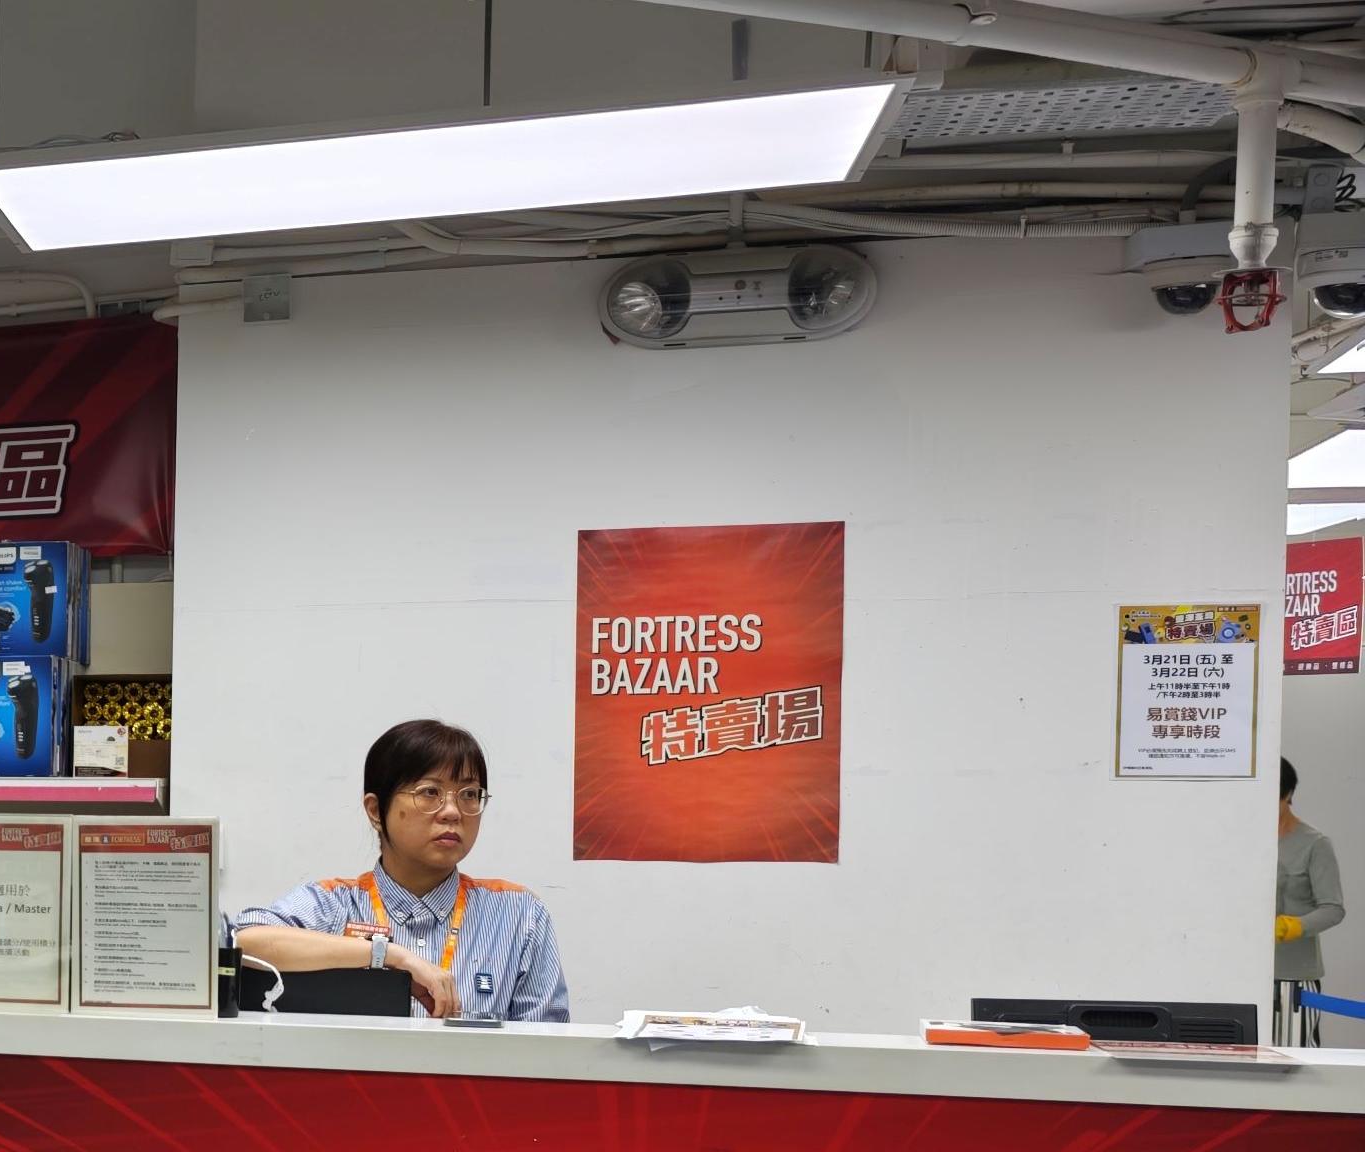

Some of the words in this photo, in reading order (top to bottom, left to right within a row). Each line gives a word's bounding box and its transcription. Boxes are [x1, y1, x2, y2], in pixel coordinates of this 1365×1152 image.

[591, 614, 763, 654] FORTRESS
[1291, 605, 1358, 650] 特賣區
[1143, 654, 1191, 665] 3月21日
[1195, 654, 1217, 666] (五)
[1221, 654, 1234, 665] 至
[591, 656, 720, 695] BAZAAR
[1151, 667, 1198, 678] 3月22日
[1203, 667, 1225, 678] (六)
[1147, 707, 1227, 722] 易賞錢VIP
[641, 687, 823, 765] 特賣場
[1152, 725, 1221, 739] 專享時段
[14, 902, 52, 914] Master
